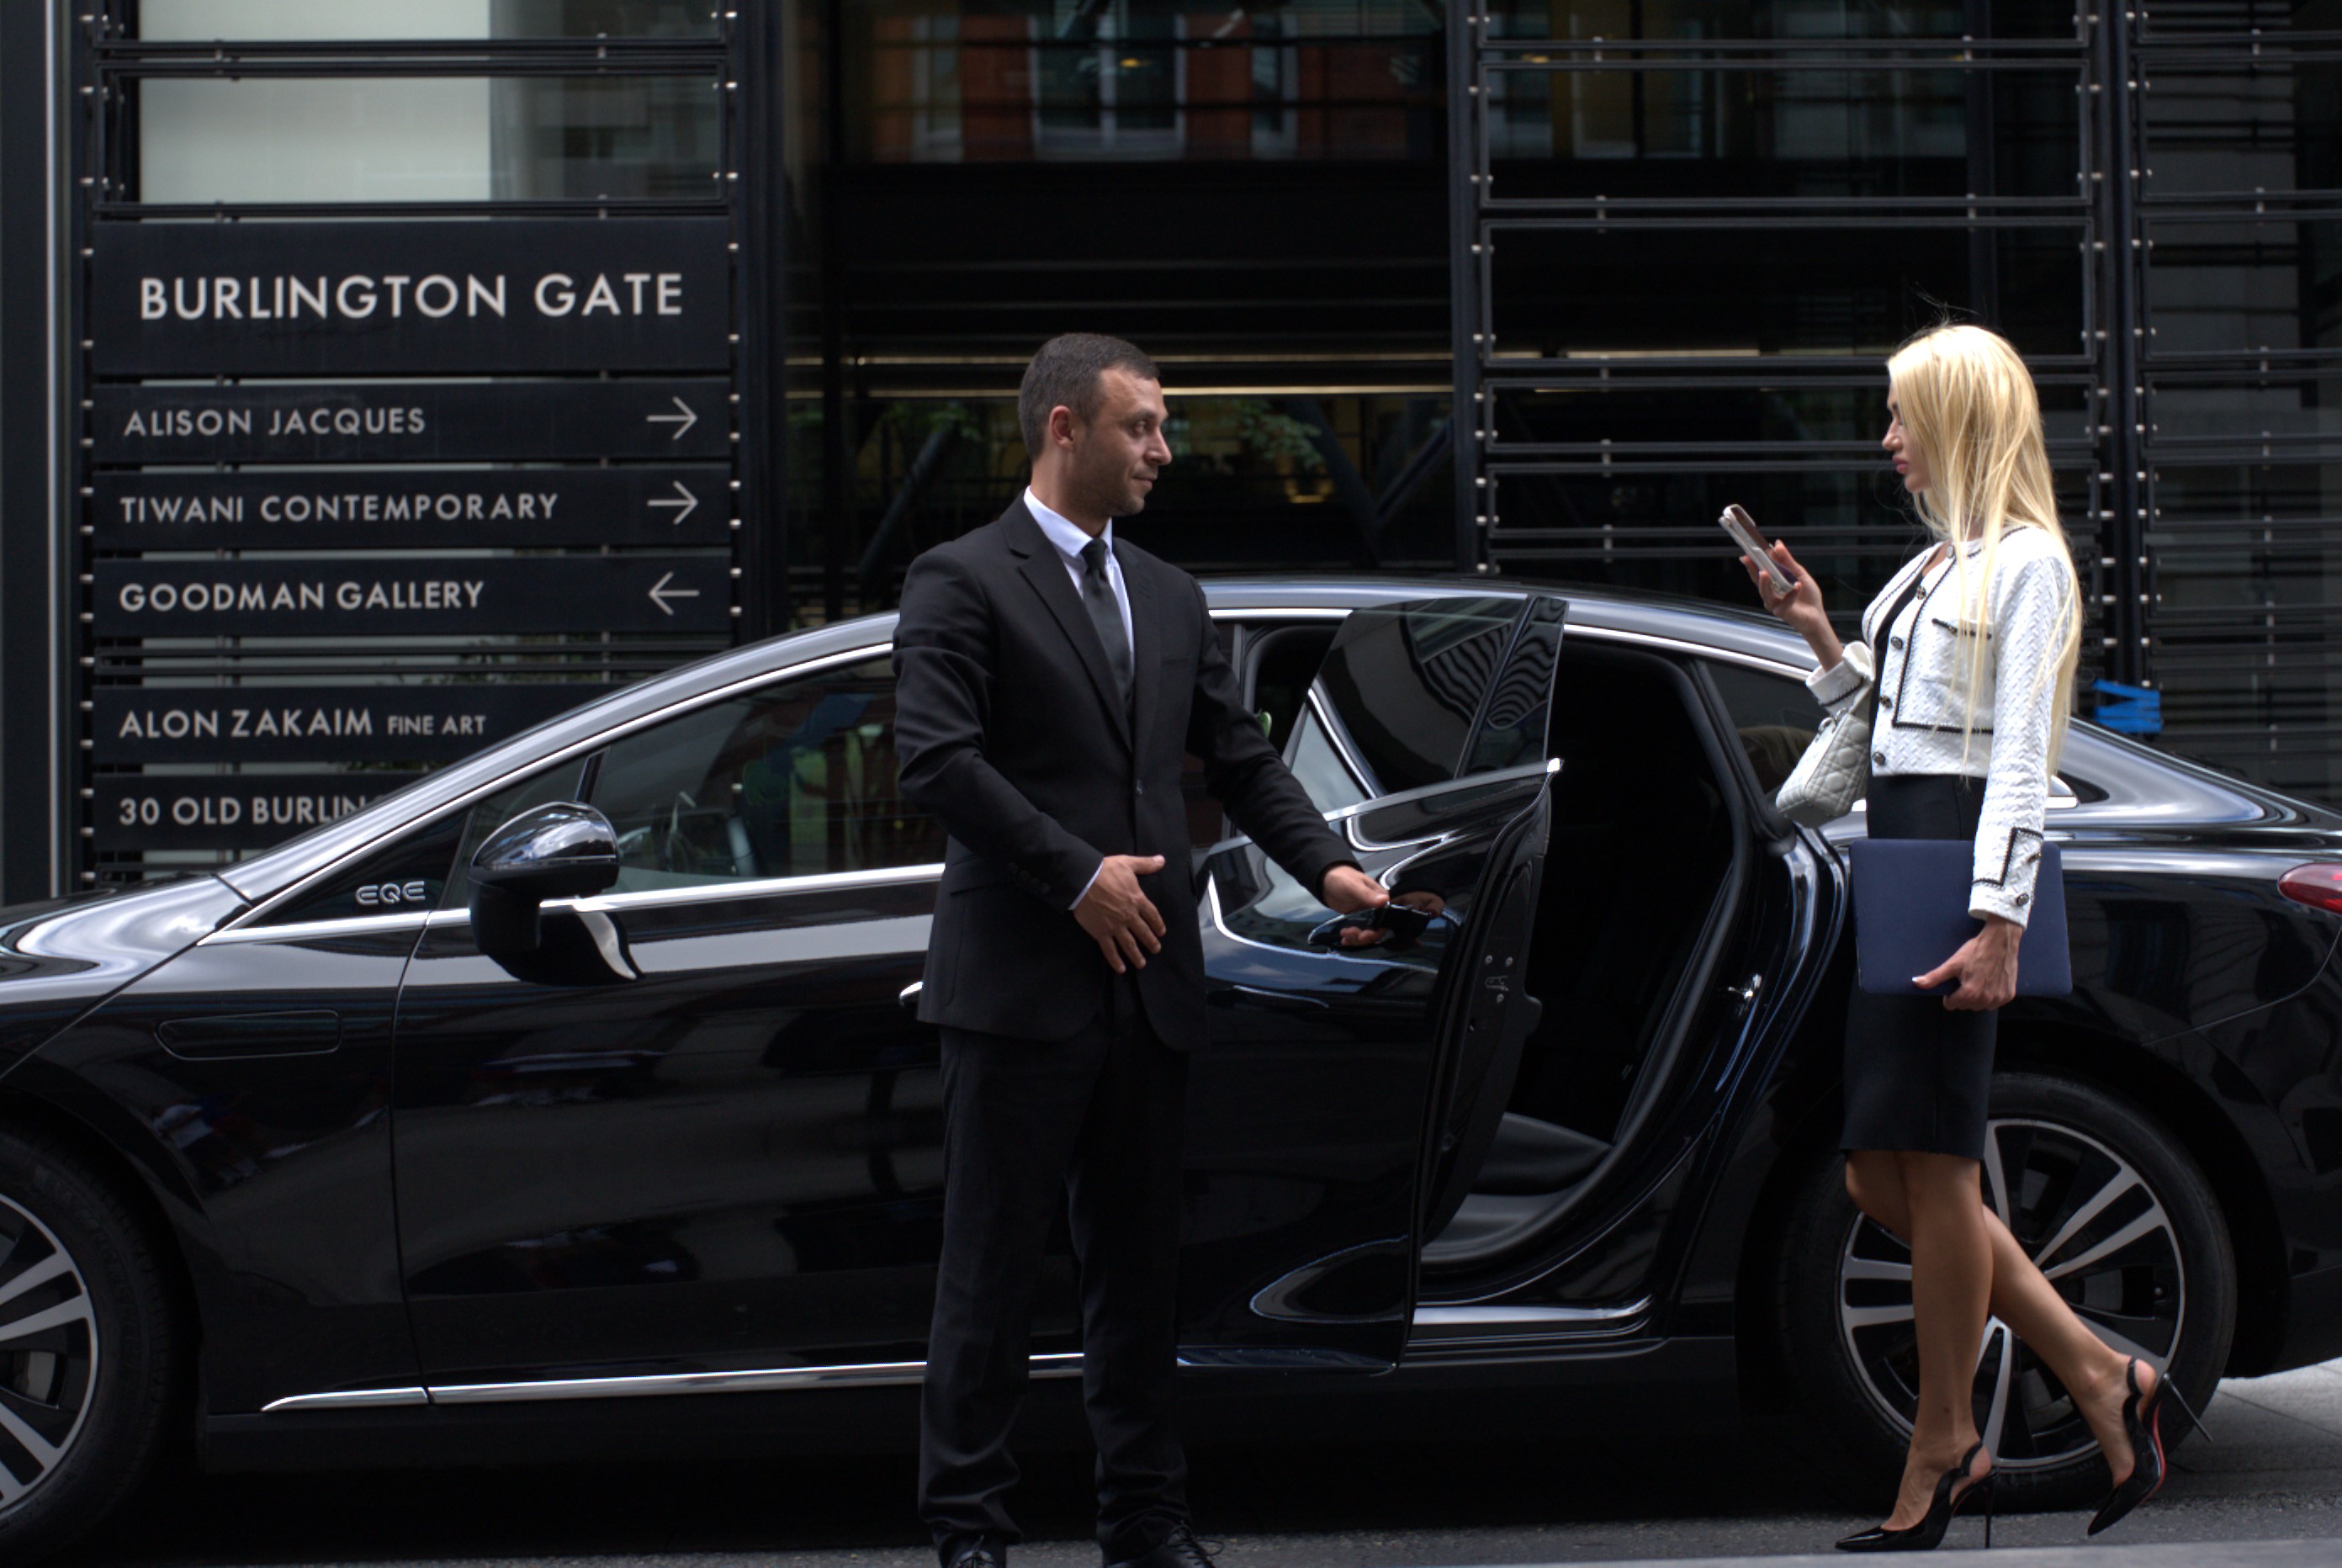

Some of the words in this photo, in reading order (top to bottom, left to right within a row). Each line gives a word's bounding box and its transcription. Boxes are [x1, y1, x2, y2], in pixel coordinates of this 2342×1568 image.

[140, 274, 506, 320] BURLINGTON
[534, 273, 682, 316] GATE
[124, 410, 252, 436] ALISON
[268, 408, 426, 435] JACQUES
[119, 496, 244, 522] TIWANI
[260, 493, 558, 522] CONTEMPORARY
[119, 582, 325, 612] GOODMAN
[336, 580, 485, 610] GALLERY
[119, 710, 219, 738] ALON
[230, 709, 373, 736] ZAKAIM
[387, 715, 434, 735] FINE
[441, 715, 486, 734] ART
[119, 797, 161, 825] 30
[172, 797, 241, 824] OLD
[252, 796, 384, 824] BURLIN
[355, 880, 426, 904] EQE
